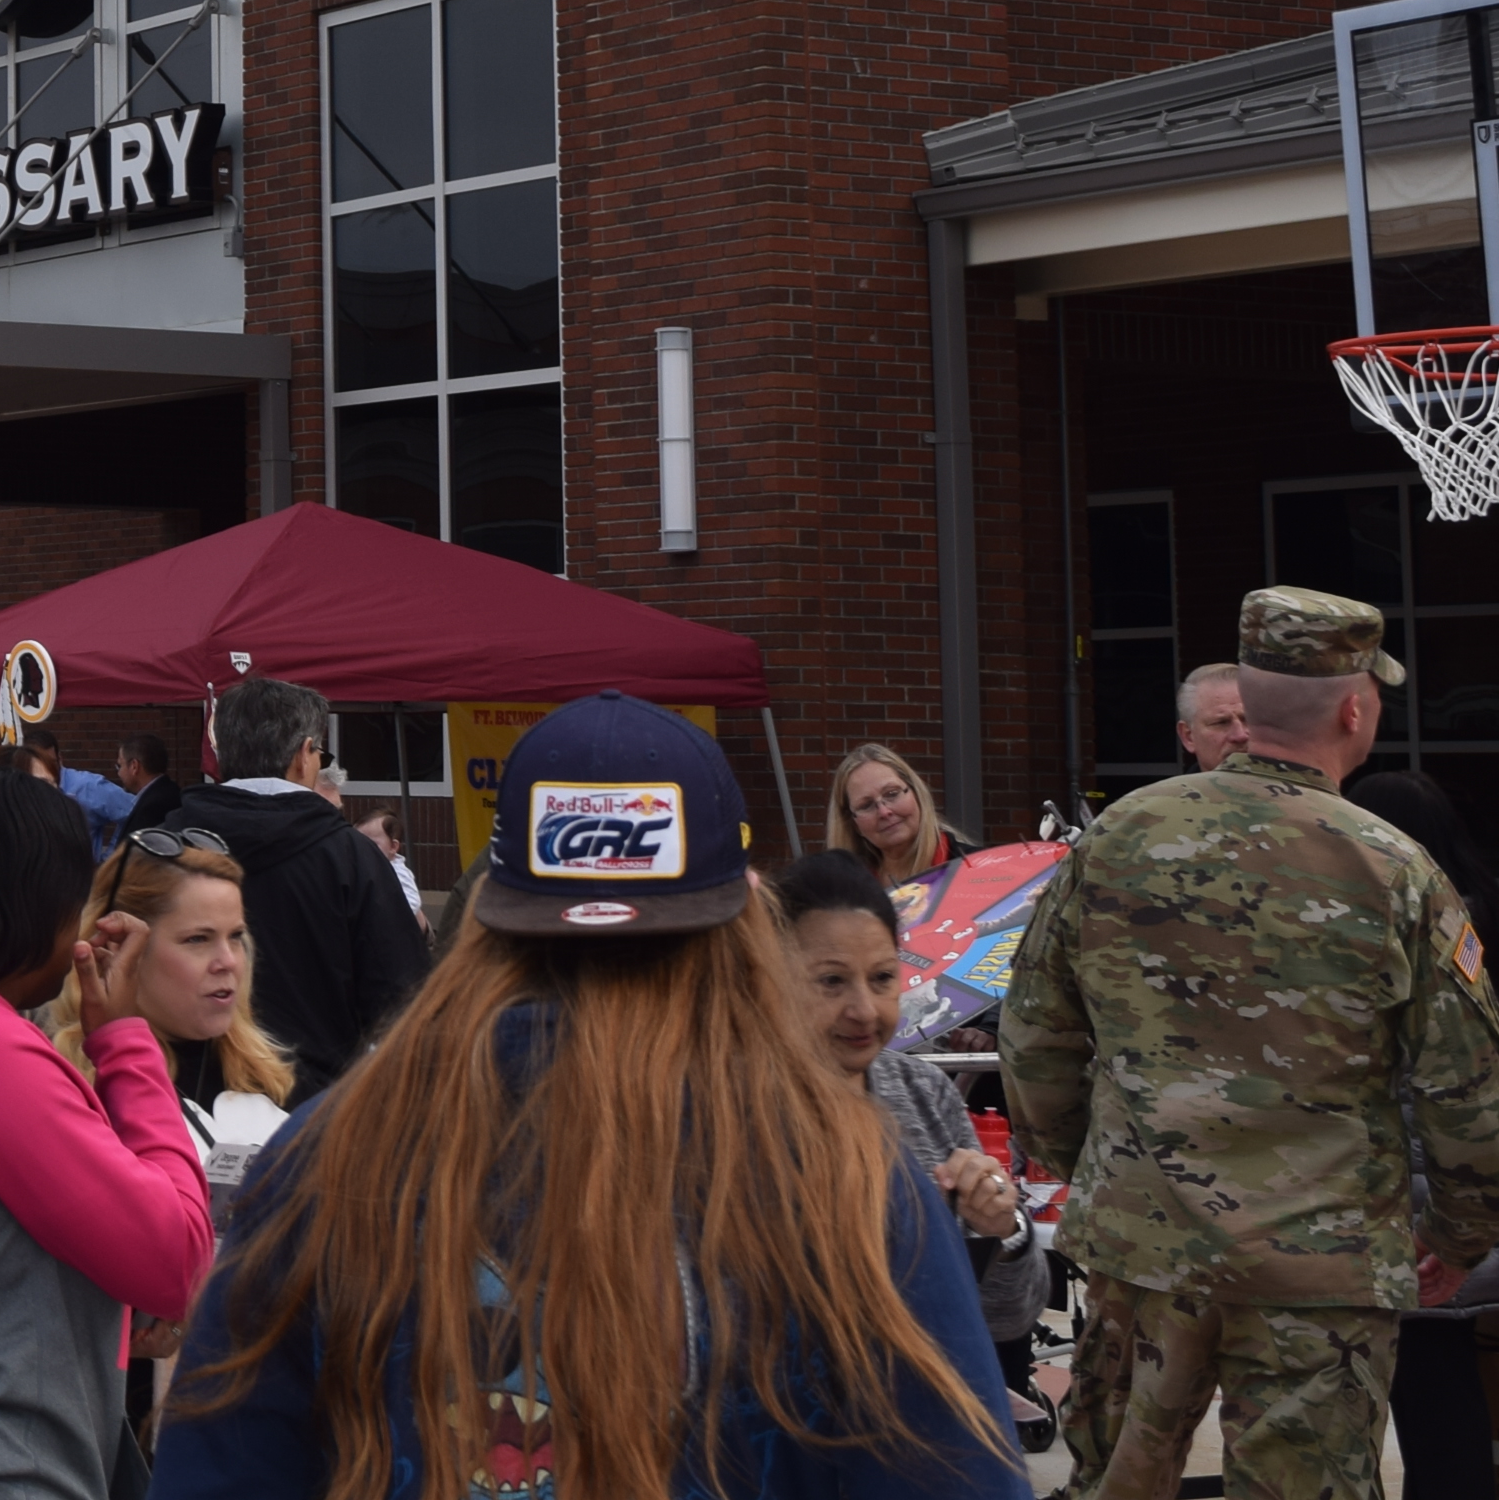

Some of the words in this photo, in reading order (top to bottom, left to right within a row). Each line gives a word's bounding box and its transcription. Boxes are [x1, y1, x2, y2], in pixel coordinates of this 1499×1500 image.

[473, 709, 493, 725] FT.
[546, 795, 576, 813] Red
[580, 797, 614, 813] Bull
[558, 817, 673, 861] GRC
